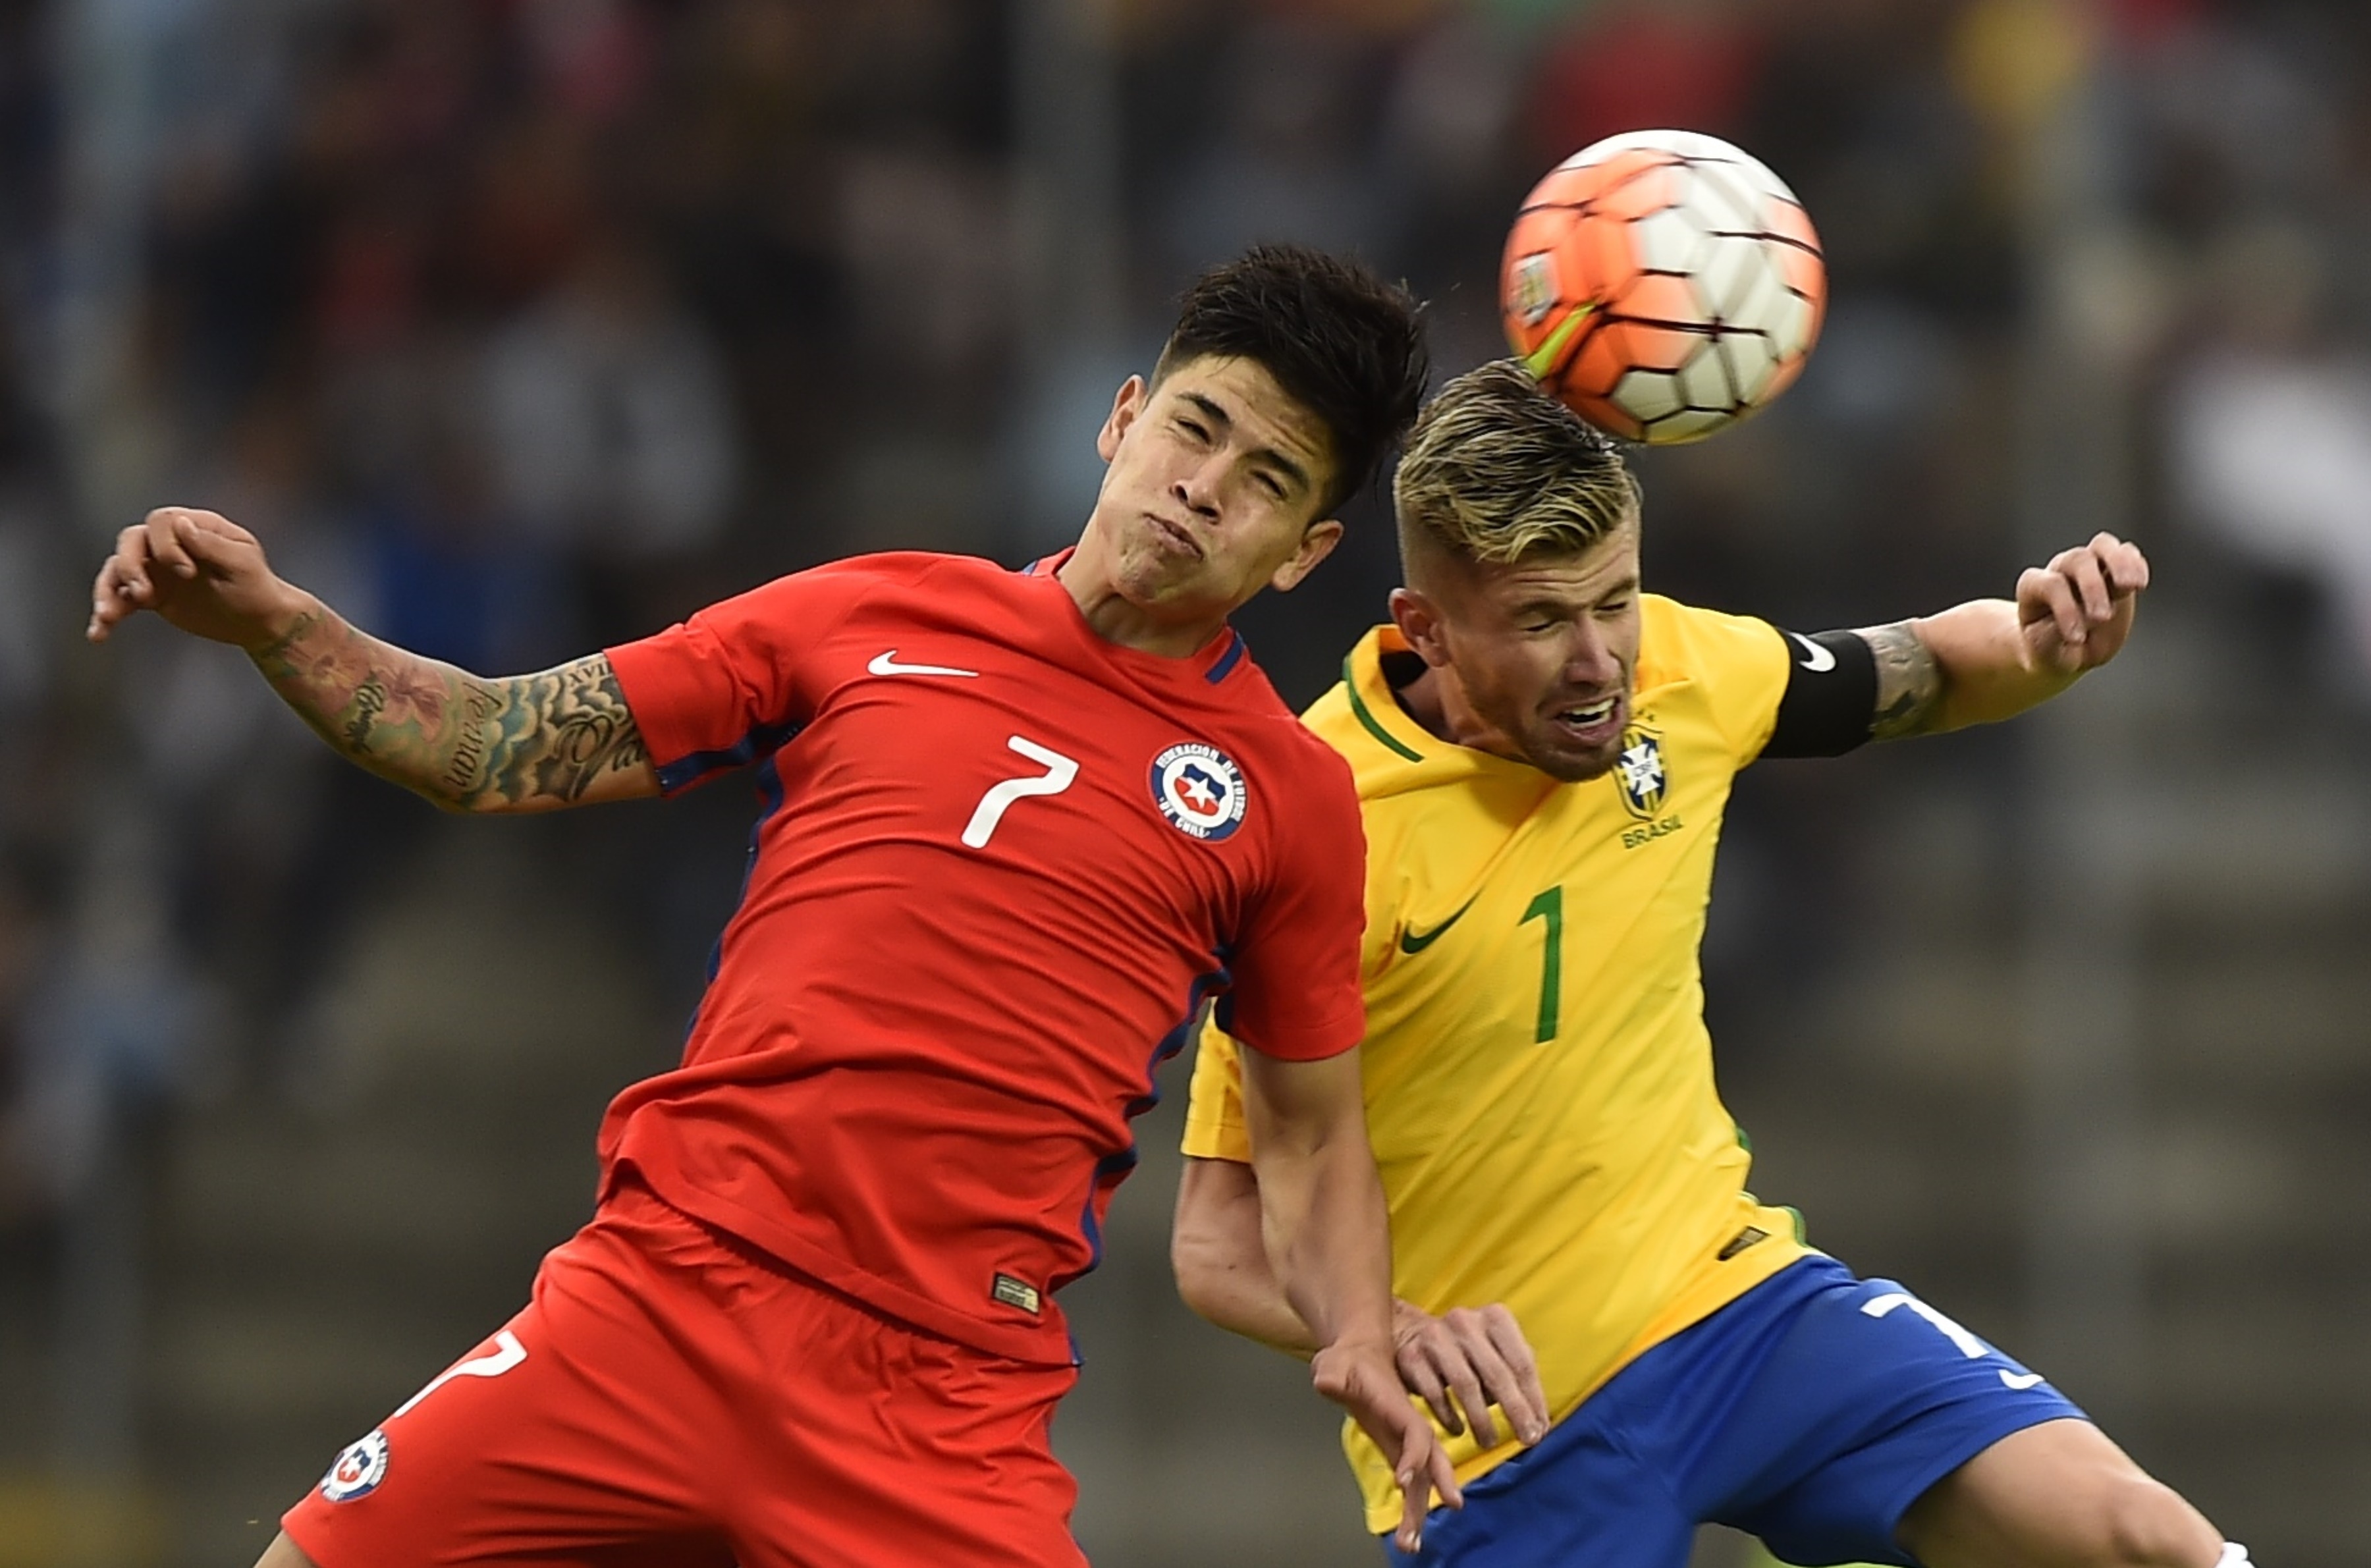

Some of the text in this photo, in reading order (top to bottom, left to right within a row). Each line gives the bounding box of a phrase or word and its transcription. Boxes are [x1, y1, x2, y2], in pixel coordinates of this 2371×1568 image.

[962, 735, 1079, 849] 7
[1622, 815, 1683, 849] BRASIL
[1517, 885, 1562, 1044] 1
[395, 1330, 528, 1417] 7
